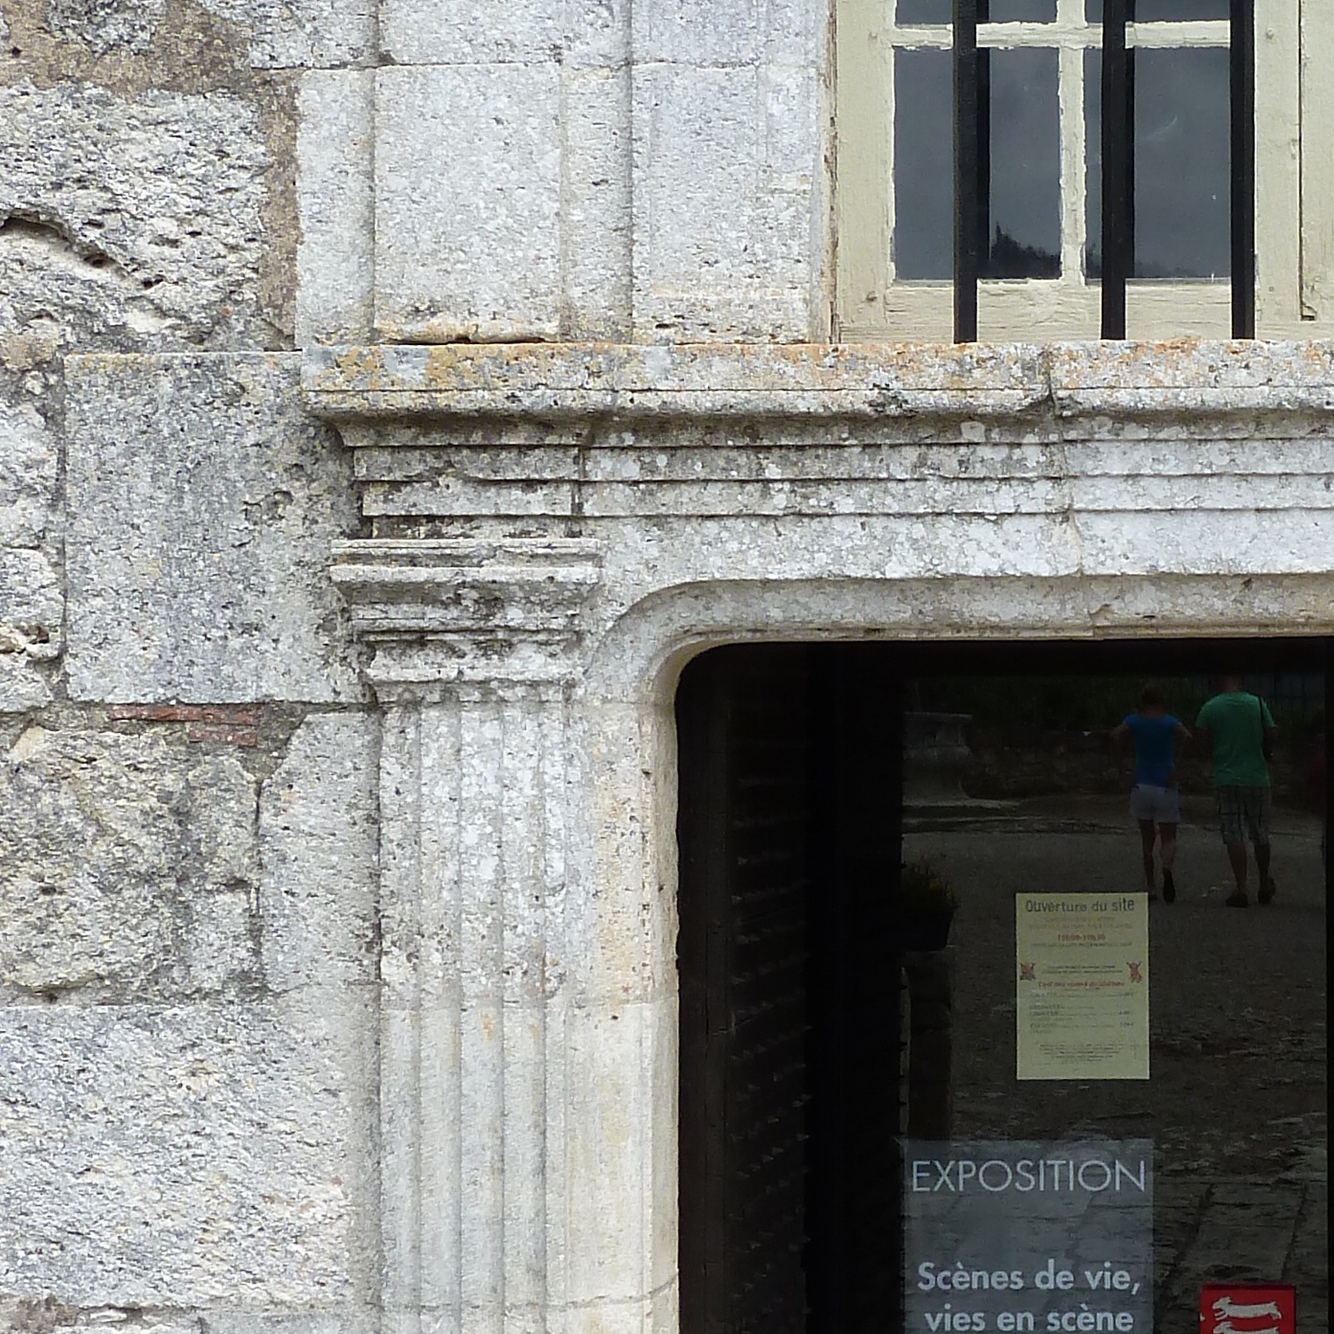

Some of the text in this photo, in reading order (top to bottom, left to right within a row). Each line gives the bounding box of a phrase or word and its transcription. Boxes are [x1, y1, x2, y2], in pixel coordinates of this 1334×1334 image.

[1025, 897, 1135, 913] Ouverture du site
[912, 1160, 1146, 1193] EXPOSITION
[917, 1259, 1141, 1296] Scènes de vie,
[924, 1303, 1135, 1333] vies en scène
